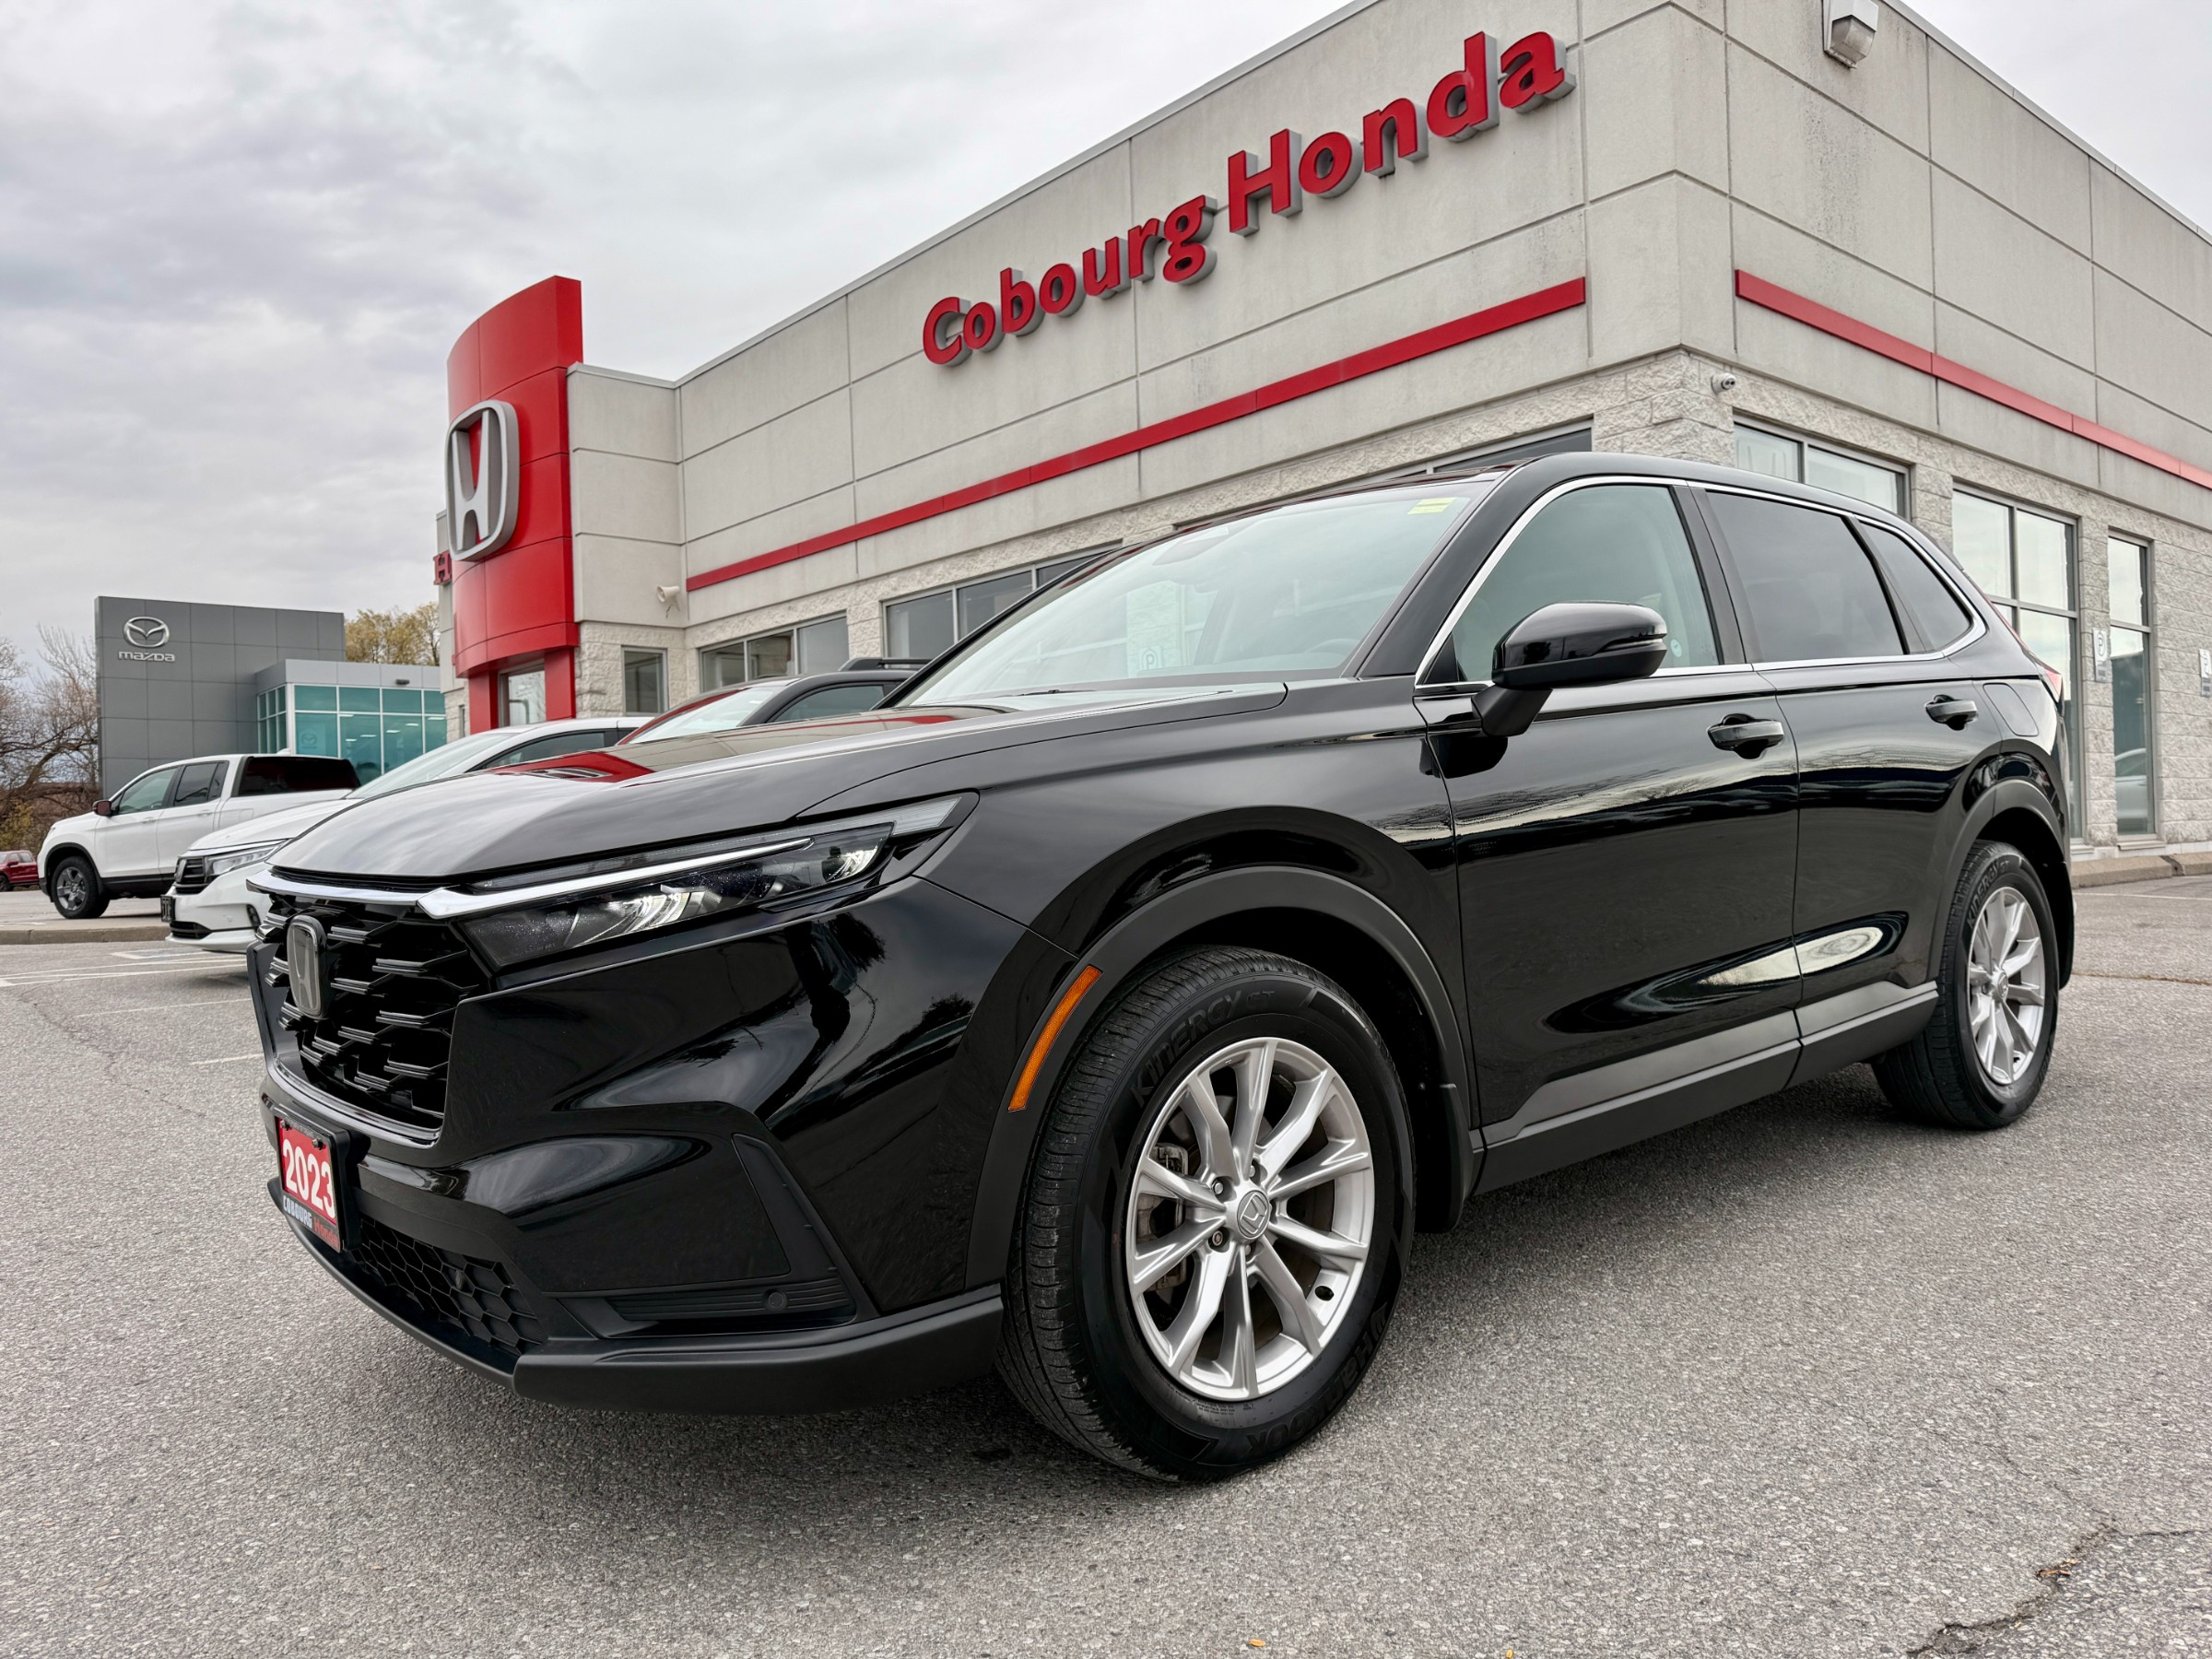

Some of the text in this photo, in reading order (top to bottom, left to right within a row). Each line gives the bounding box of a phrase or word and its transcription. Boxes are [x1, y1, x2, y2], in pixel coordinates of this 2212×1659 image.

[923, 30, 1568, 365] Cobourg Honda
[118, 651, 176, 663] mazda
[282, 1138, 336, 1219] 2023
[282, 1195, 312, 1229] COBOURG
